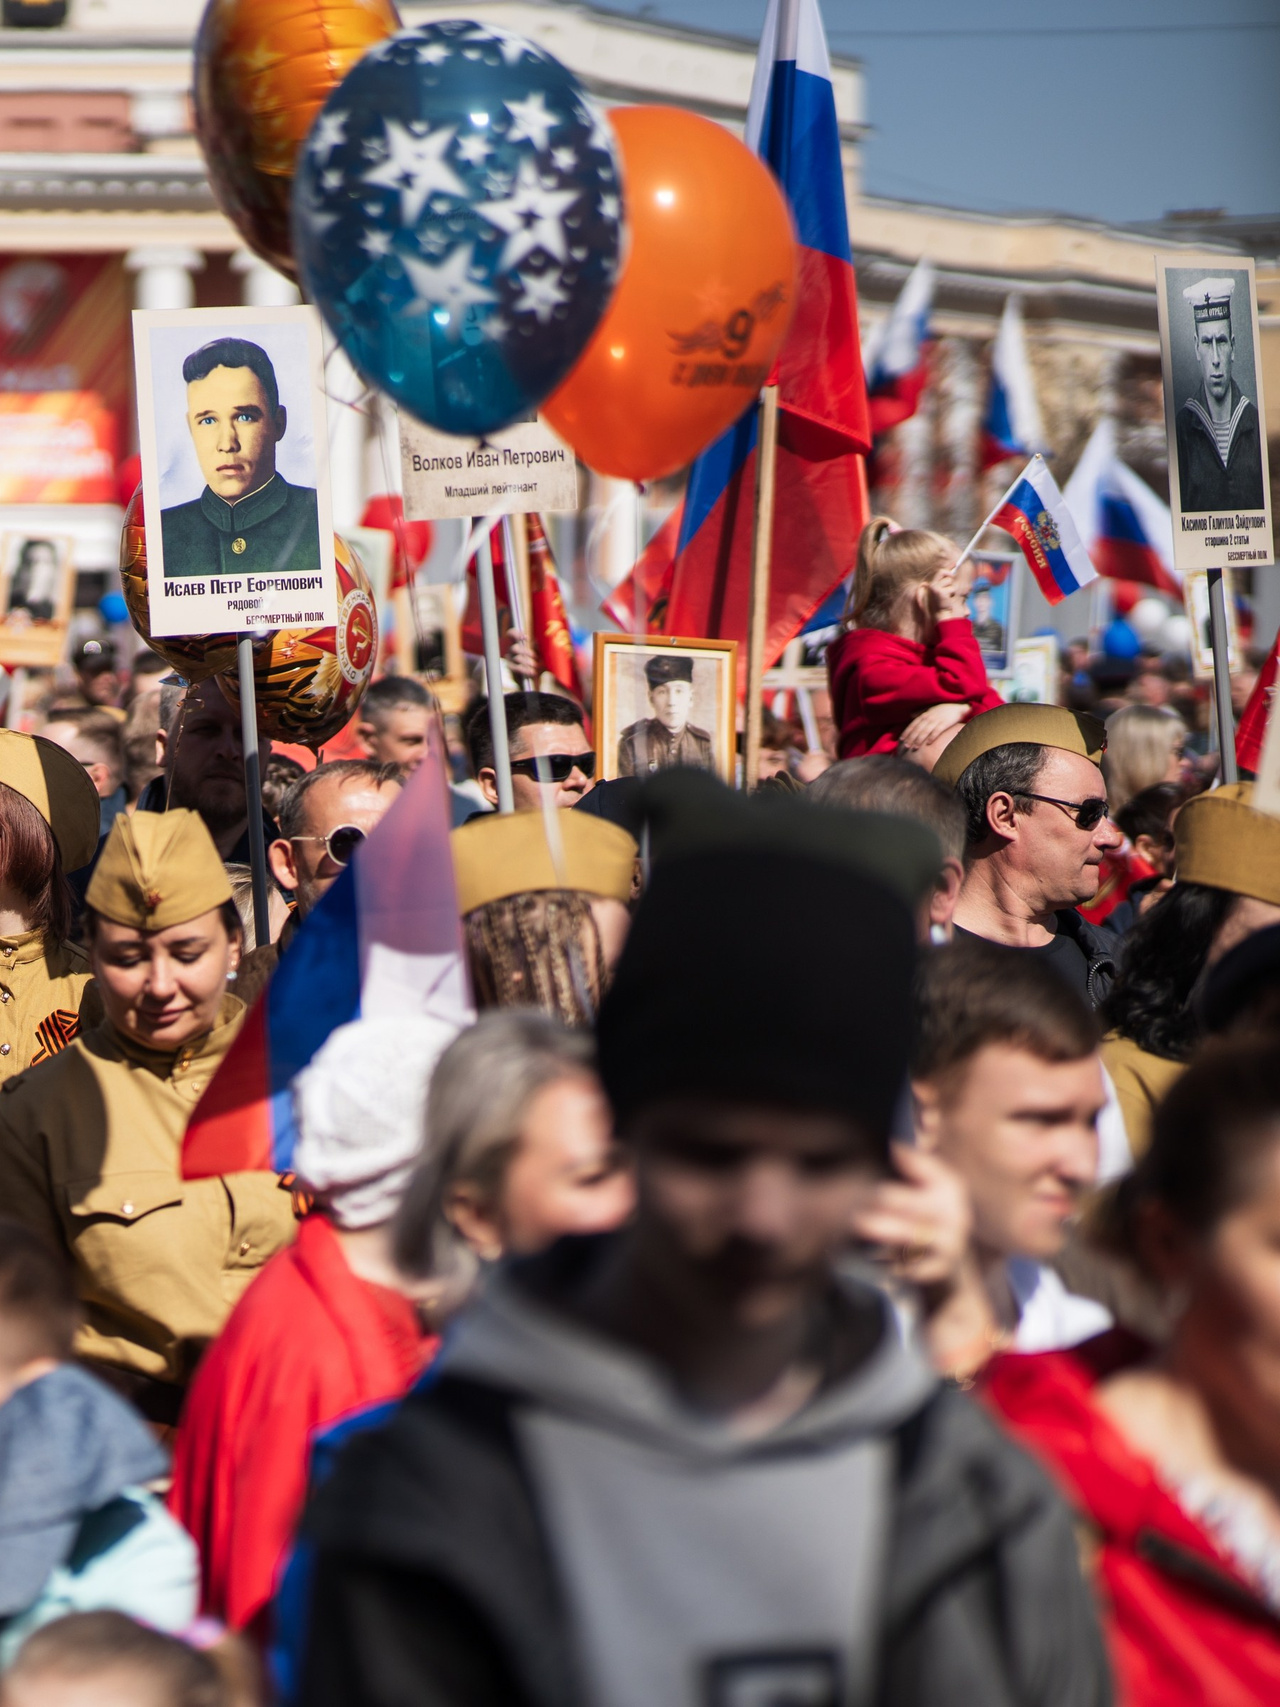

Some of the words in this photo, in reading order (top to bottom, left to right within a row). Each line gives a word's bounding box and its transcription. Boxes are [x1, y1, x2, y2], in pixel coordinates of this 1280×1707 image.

[412, 455, 463, 472] Волков
[467, 451, 499, 468] Иван
[503, 449, 565, 468] Петрович
[444, 483, 489, 498] Младший
[491, 482, 538, 496] лейтенант
[1014, 516, 1047, 569] РОССИЯ
[245, 611, 303, 625] БЕССМЕРТНЫЙ
[304, 611, 325, 622] ПОЛК
